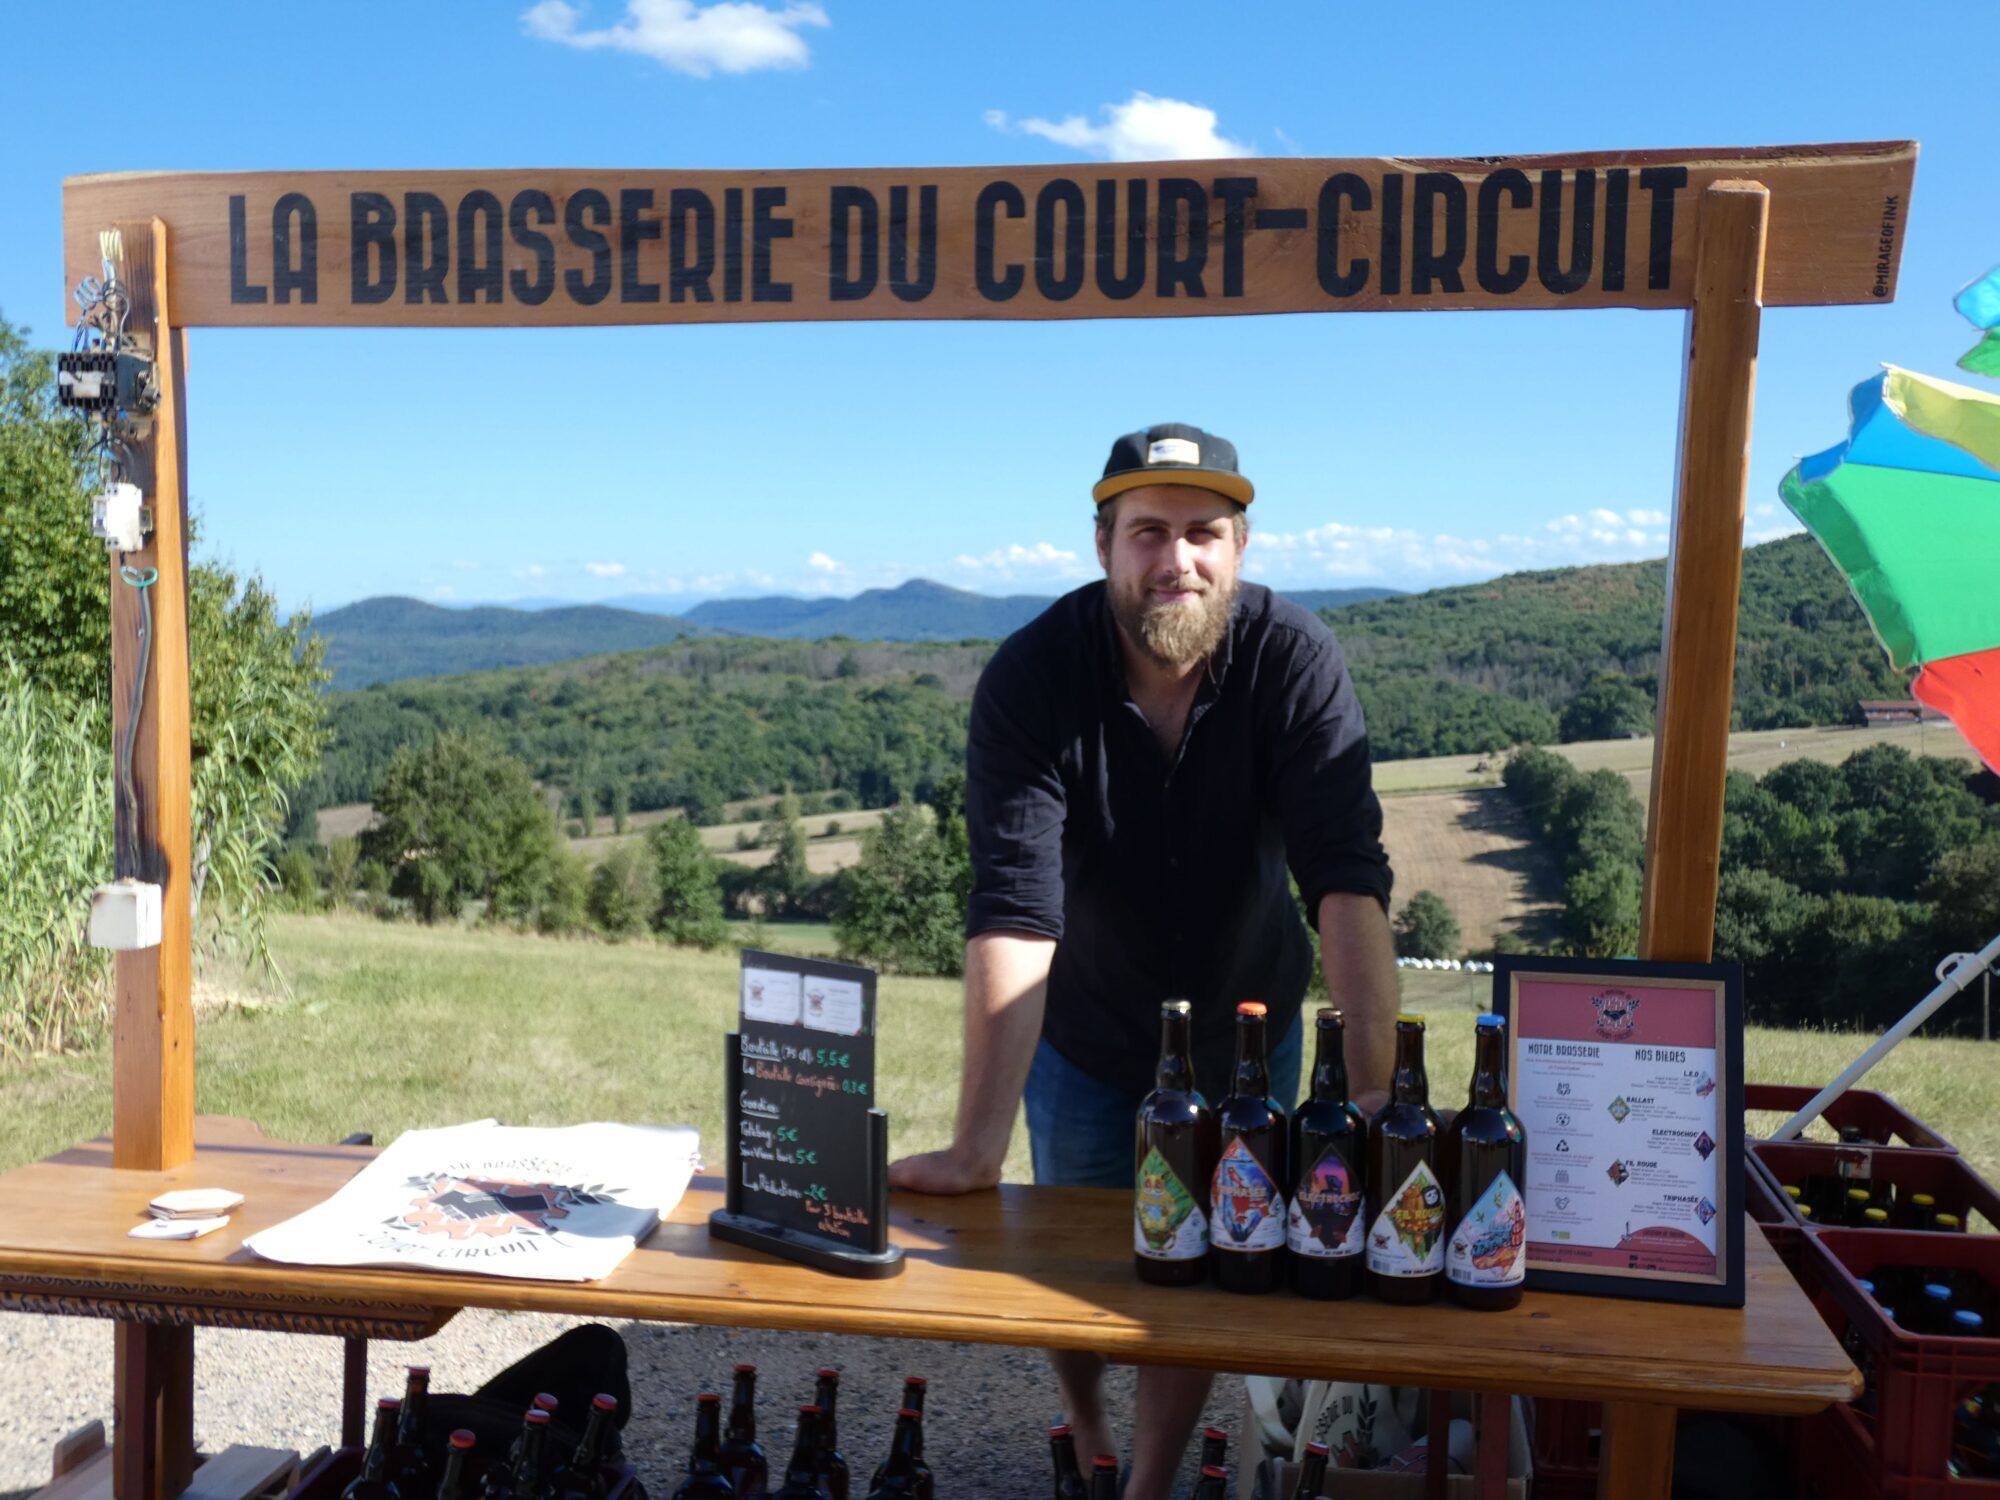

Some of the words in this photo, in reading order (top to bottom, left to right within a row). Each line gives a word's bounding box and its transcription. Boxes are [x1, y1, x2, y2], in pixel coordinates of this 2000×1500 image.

[229, 191, 319, 305] LA
[350, 186, 794, 306] BRASSERIE
[830, 184, 938, 302] DU
[975, 166, 1688, 302] COURT-CIRCUIT
[1872, 194, 1899, 298] @MIRAGEOFINK
[816, 1048, 850, 1069] 5,5€
[1528, 1043, 1553, 1055] NOTRE
[1556, 1044, 1600, 1058] BRASSERIE
[1635, 1049, 1653, 1062] NOS
[841, 1079, 868, 1096] 0,3€
[1626, 1096, 1655, 1104] BALLAST
[776, 1125, 799, 1142] 5€
[795, 1148, 817, 1165] 5€
[1636, 1160, 1658, 1168] ROUGE
[1663, 1194, 1699, 1203] TRIPHASÉE
